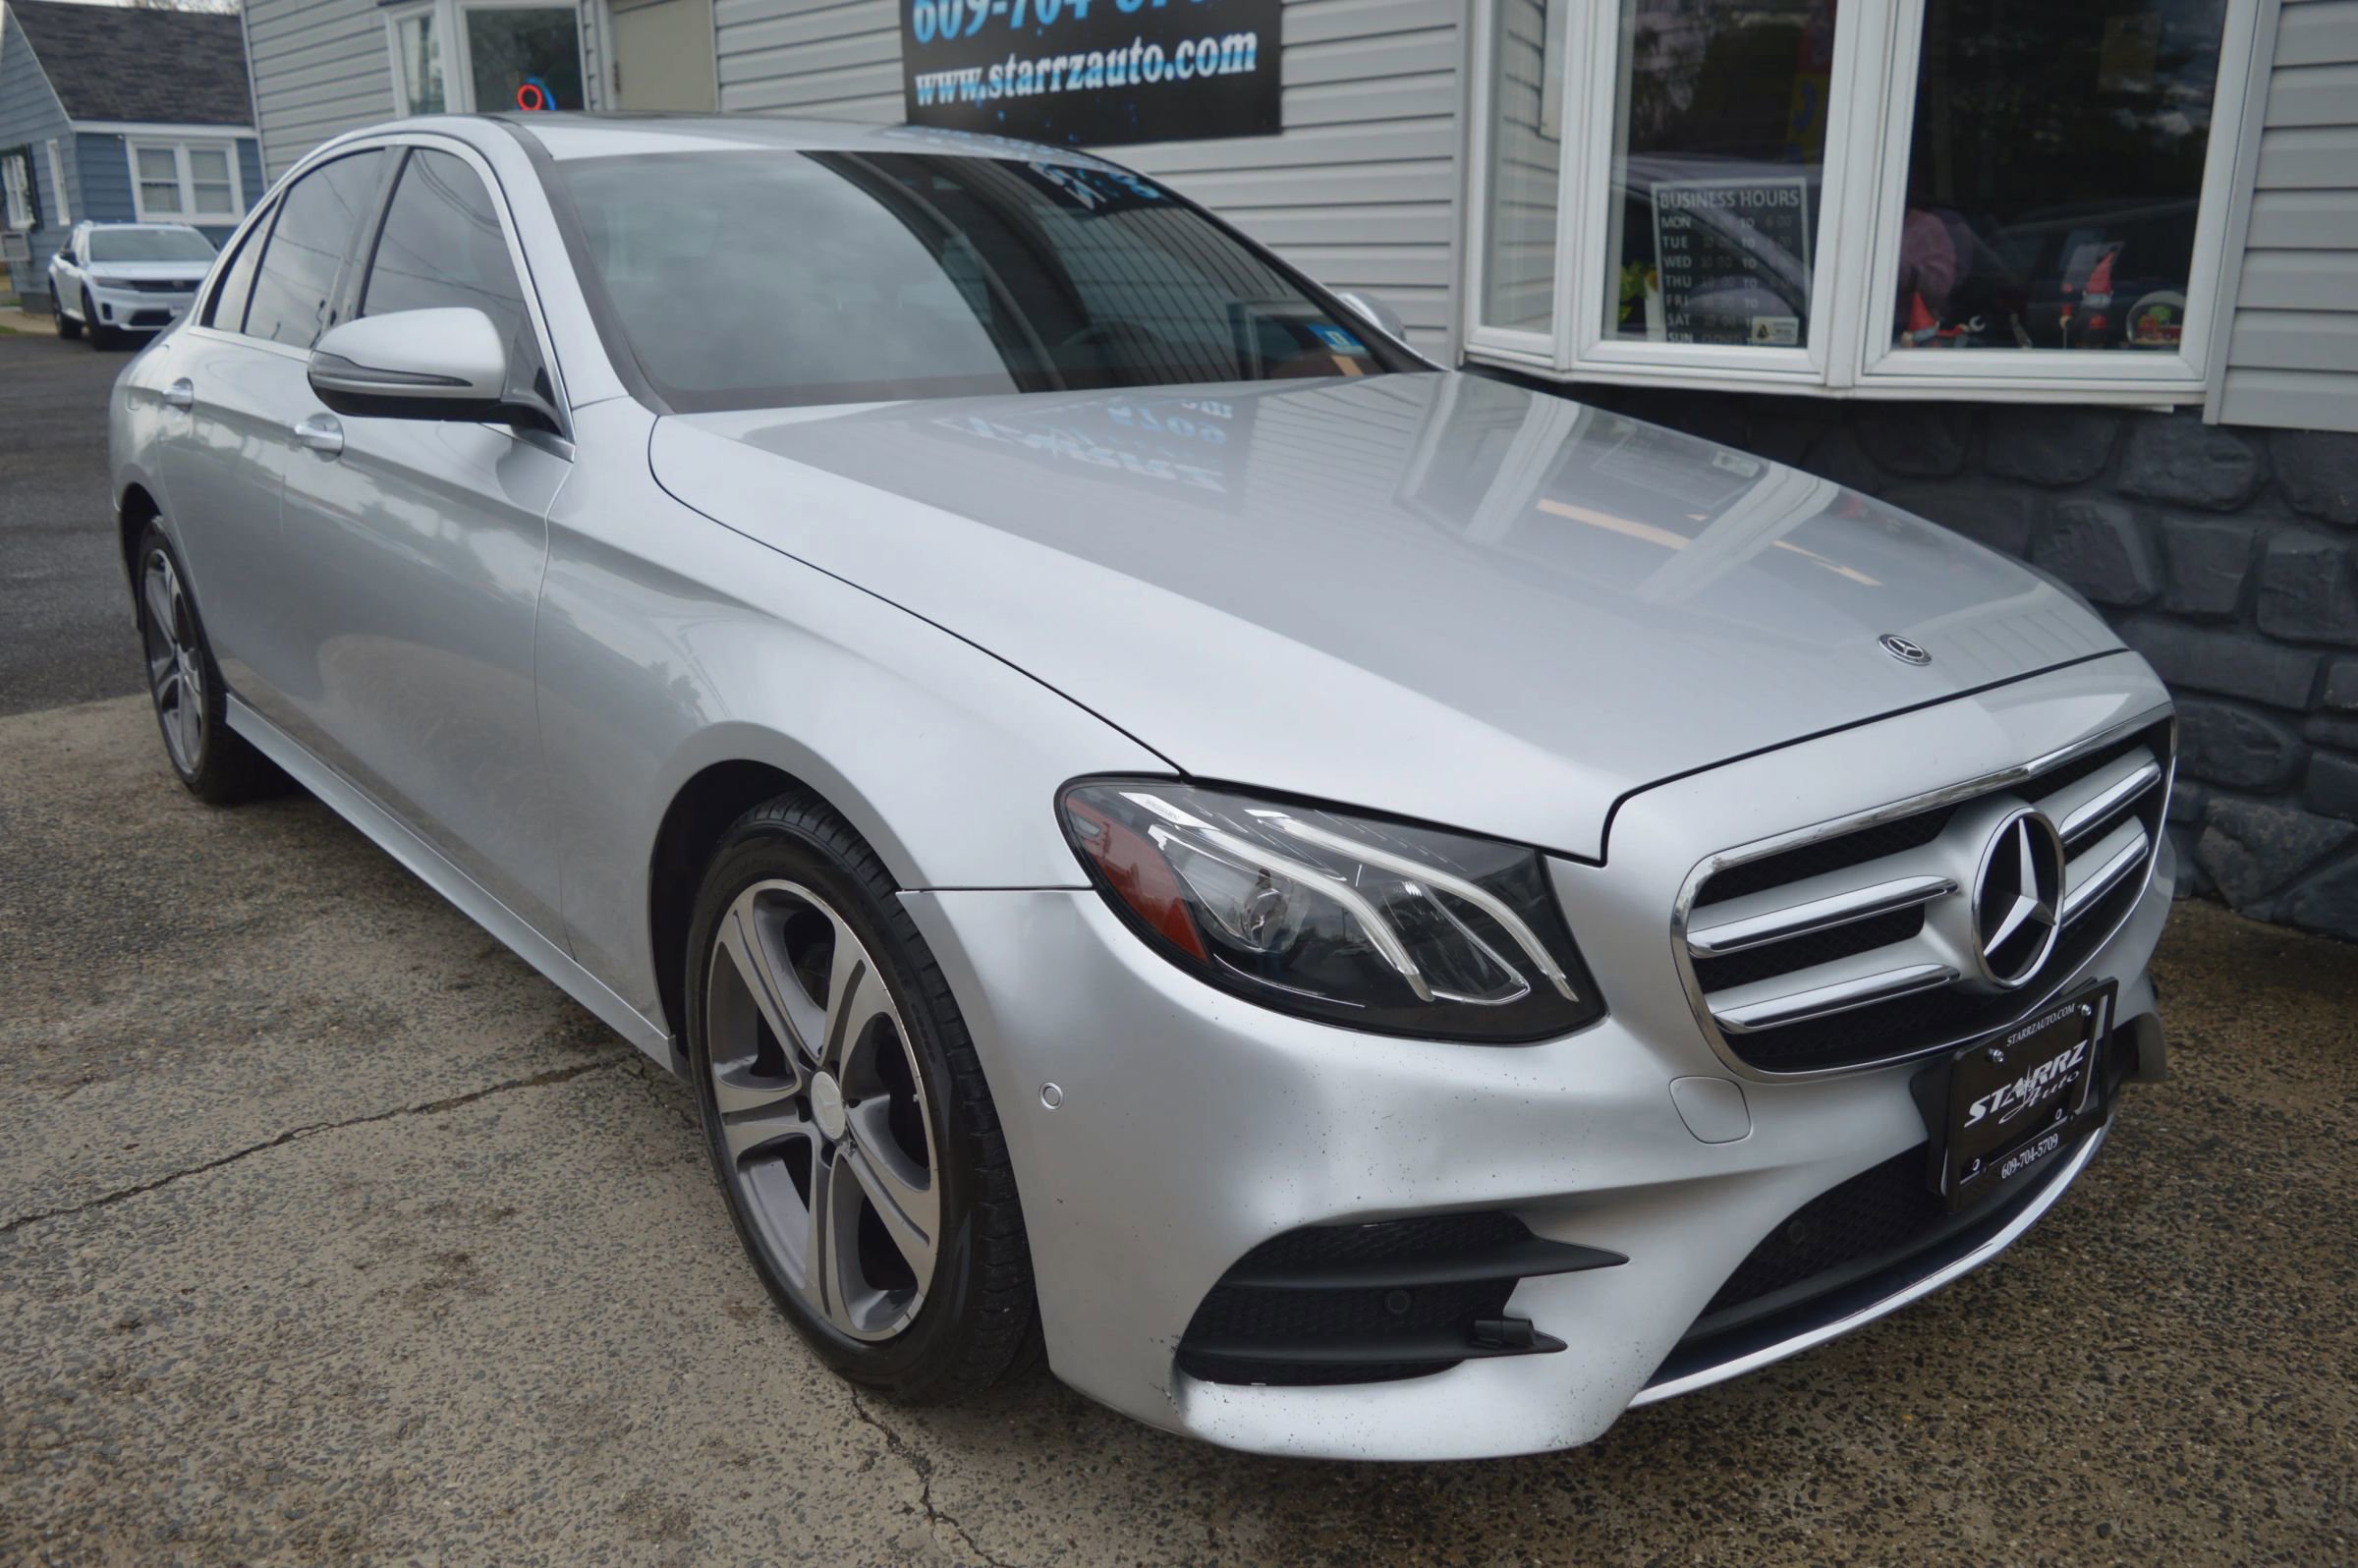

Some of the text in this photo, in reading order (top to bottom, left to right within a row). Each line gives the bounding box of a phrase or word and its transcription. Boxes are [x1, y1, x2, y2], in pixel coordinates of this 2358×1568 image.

[915, 31, 1258, 106] www.starrzauto.com
[1659, 189, 1800, 208] BUSINESS HOURS
[1660, 215, 1691, 229] MON
[1662, 236, 1689, 249] TUE
[1663, 255, 1692, 268] WED
[1664, 275, 1692, 288] THU
[1665, 294, 1689, 307] FRI
[1666, 313, 1691, 326] SAT
[2006, 1003, 2076, 1047] STARRZAUTO.COM
[1964, 1039, 2089, 1128] STARRZ
[1998, 1070, 2080, 1125] Auto
[2000, 1133, 2059, 1180] 609-704-5709
